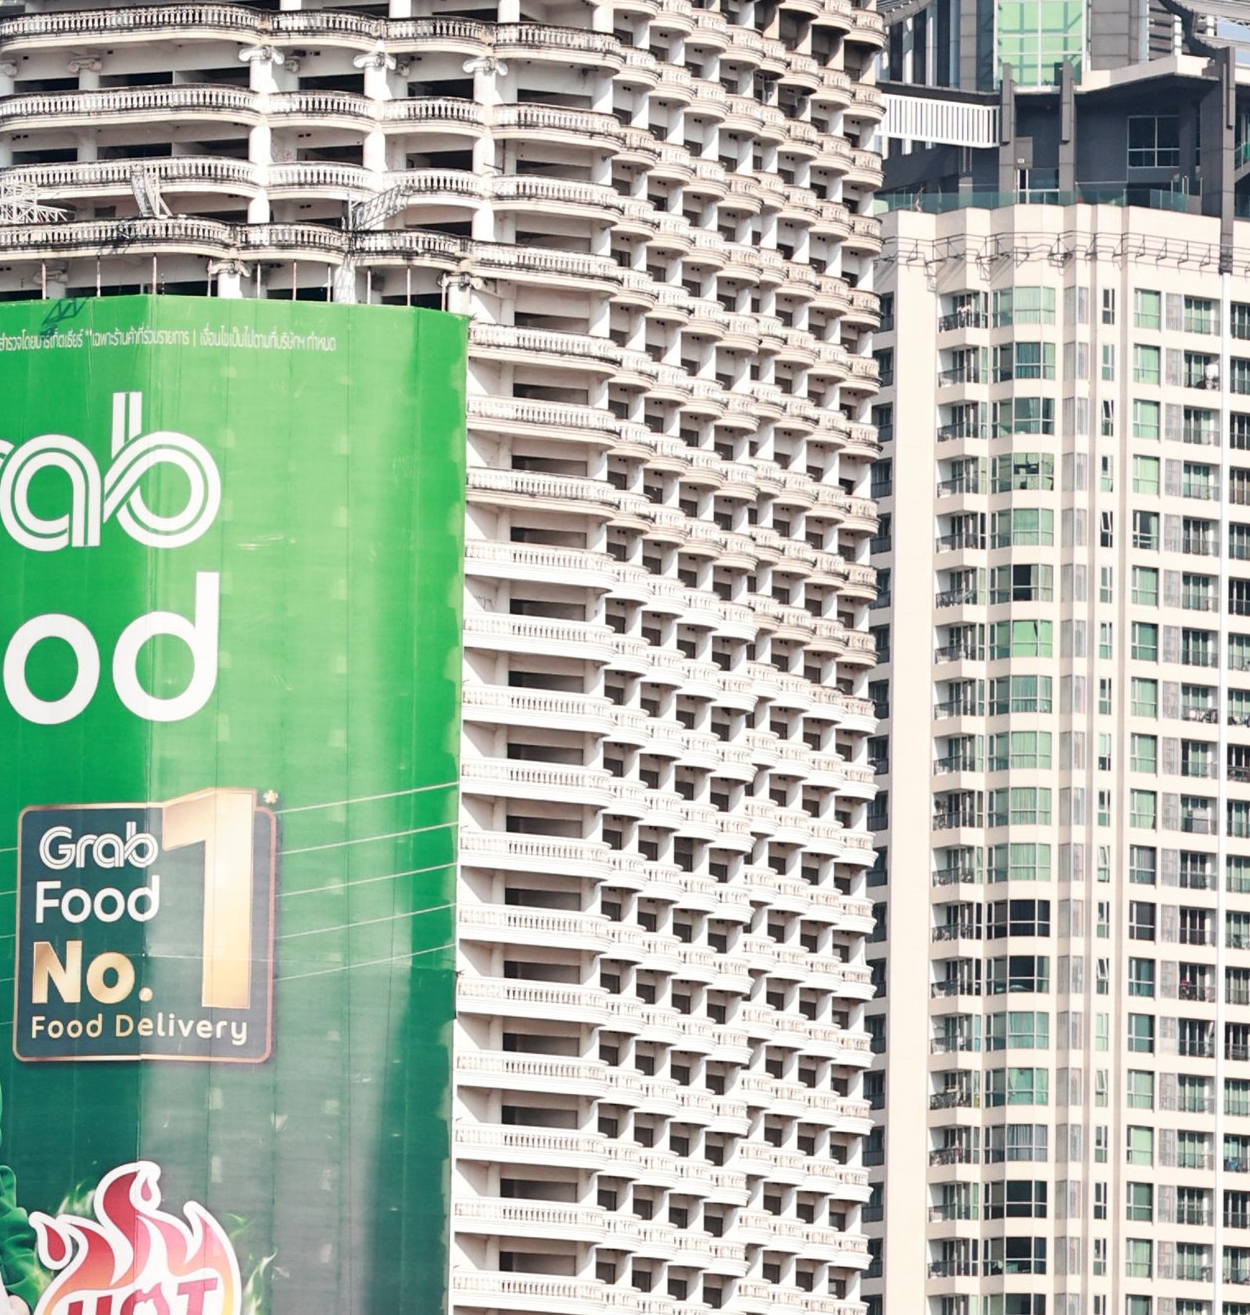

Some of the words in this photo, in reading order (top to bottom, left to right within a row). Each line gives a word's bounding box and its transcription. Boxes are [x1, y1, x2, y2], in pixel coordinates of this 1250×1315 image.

[38, 821, 159, 870] Grab
[34, 875, 160, 924] Food
[30, 939, 154, 1005] No.
[30, 1014, 102, 1039] Food
[114, 1012, 249, 1046] Delivery
